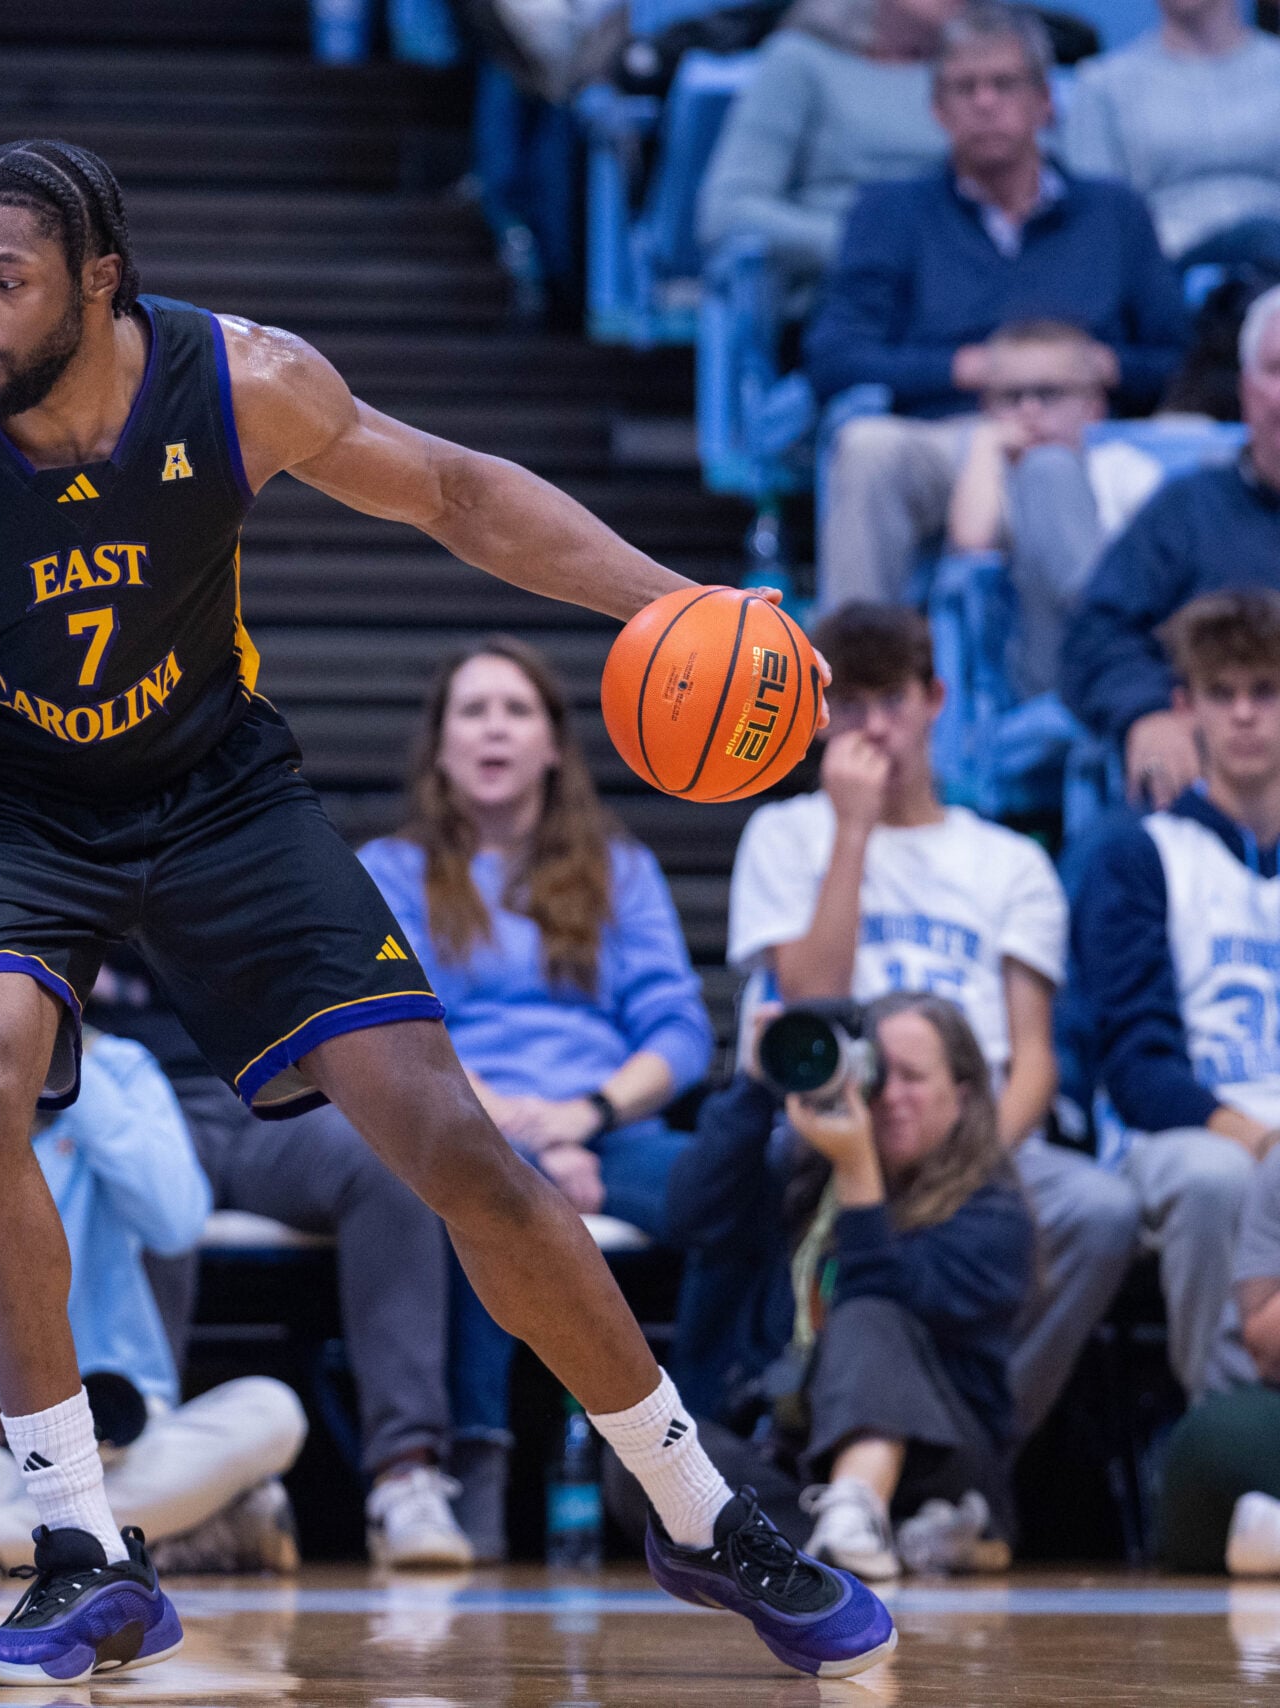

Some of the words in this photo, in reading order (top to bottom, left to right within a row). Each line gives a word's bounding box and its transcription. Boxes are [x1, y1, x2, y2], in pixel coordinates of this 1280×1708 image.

[27, 542, 151, 610] EAST
[66, 604, 119, 690] 7
[725, 646, 761, 755] CHAIONSHIP
[733, 648, 788, 762] ELITE
